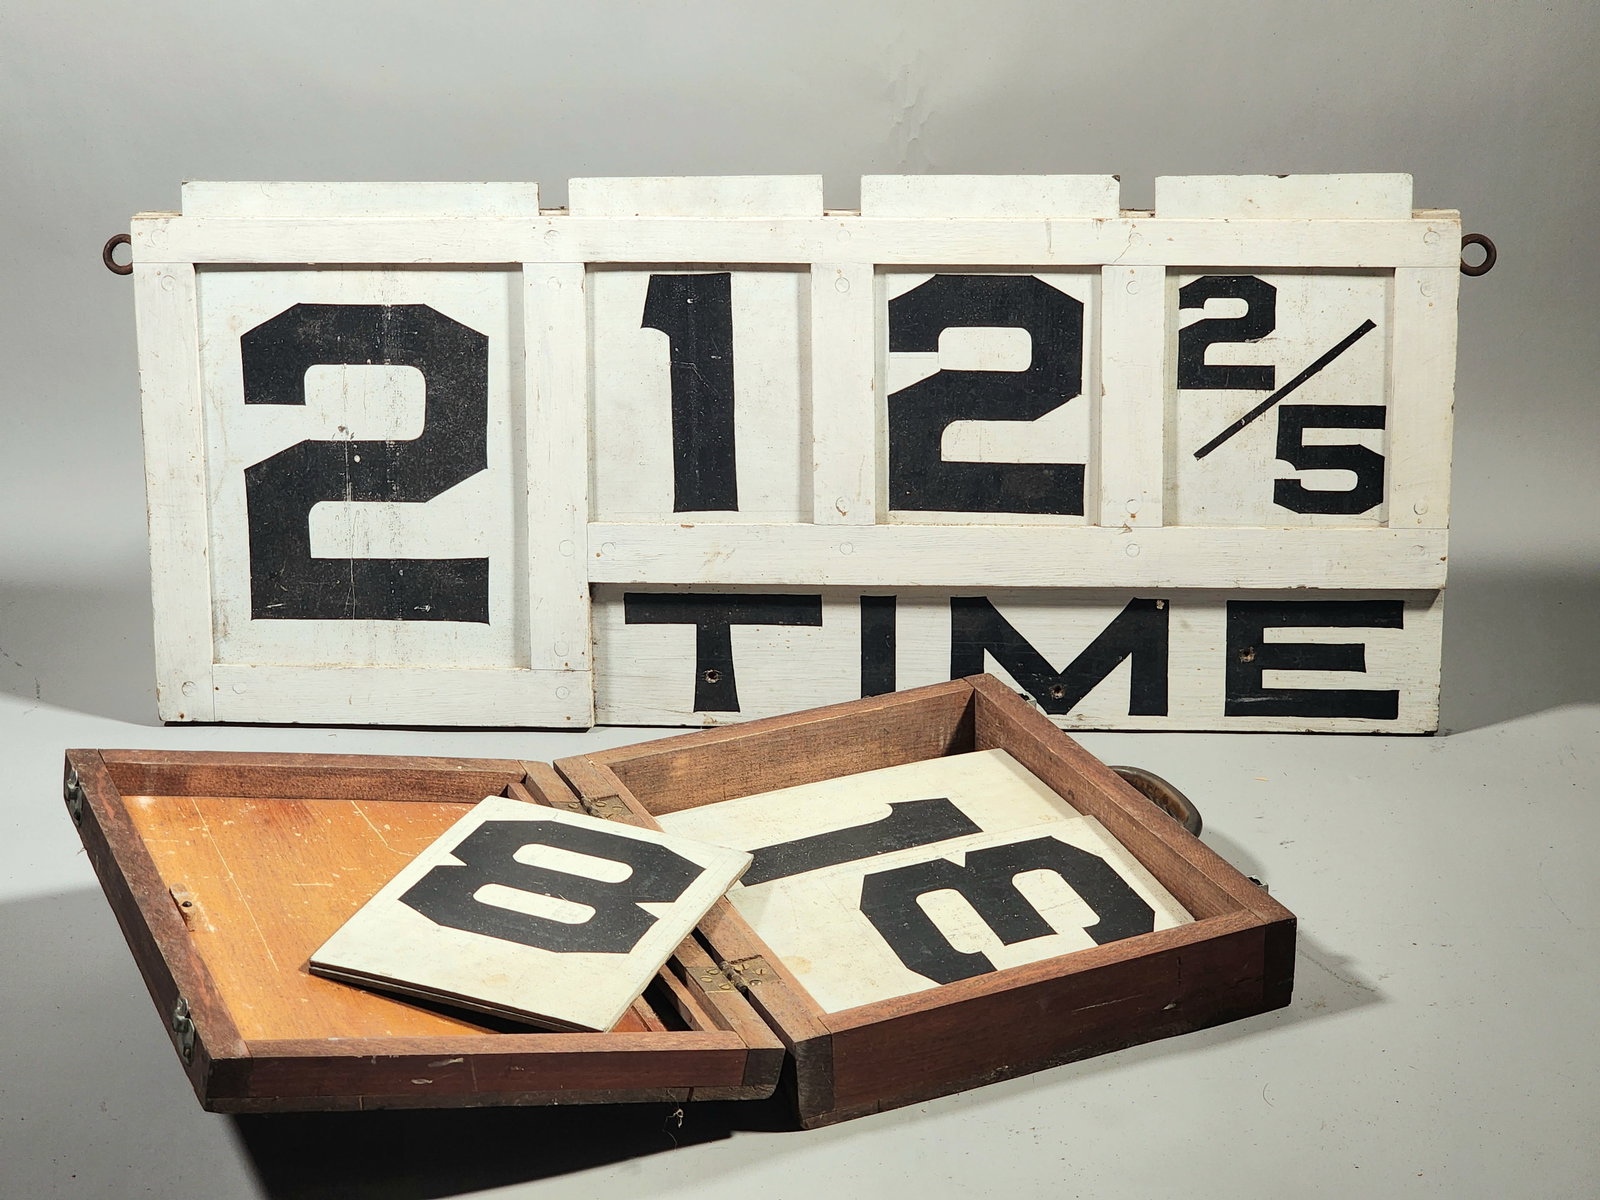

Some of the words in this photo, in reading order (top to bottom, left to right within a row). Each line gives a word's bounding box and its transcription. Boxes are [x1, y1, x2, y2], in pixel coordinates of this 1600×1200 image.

[241, 303, 490, 624] 2
[625, 593, 1404, 720] TIME
[400, 821, 705, 953] 8
[861, 837, 1155, 985] 3
